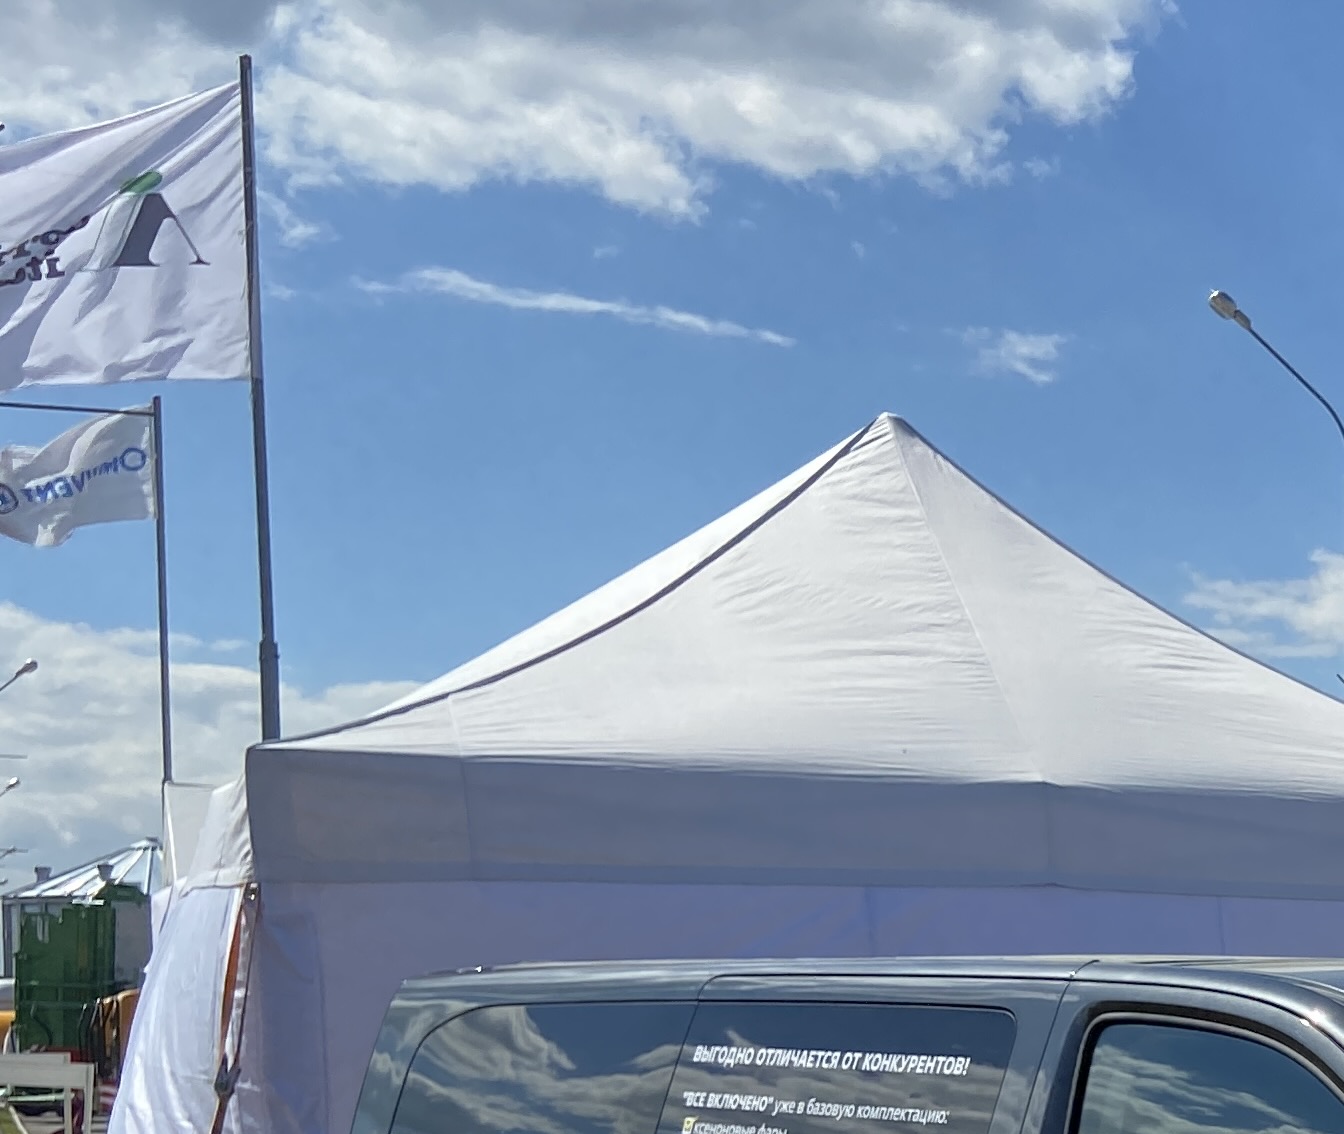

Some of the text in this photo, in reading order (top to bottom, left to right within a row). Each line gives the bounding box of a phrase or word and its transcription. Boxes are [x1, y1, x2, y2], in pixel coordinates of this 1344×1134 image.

[693, 1045, 971, 1077] ВЫГОДНО ОТЛИЧАЕТСЯ ОТ КОНКУРЕНТОВ!
[771, 1099, 796, 1117] уже
[797, 1101, 804, 1115] в
[806, 1098, 855, 1122] базовую
